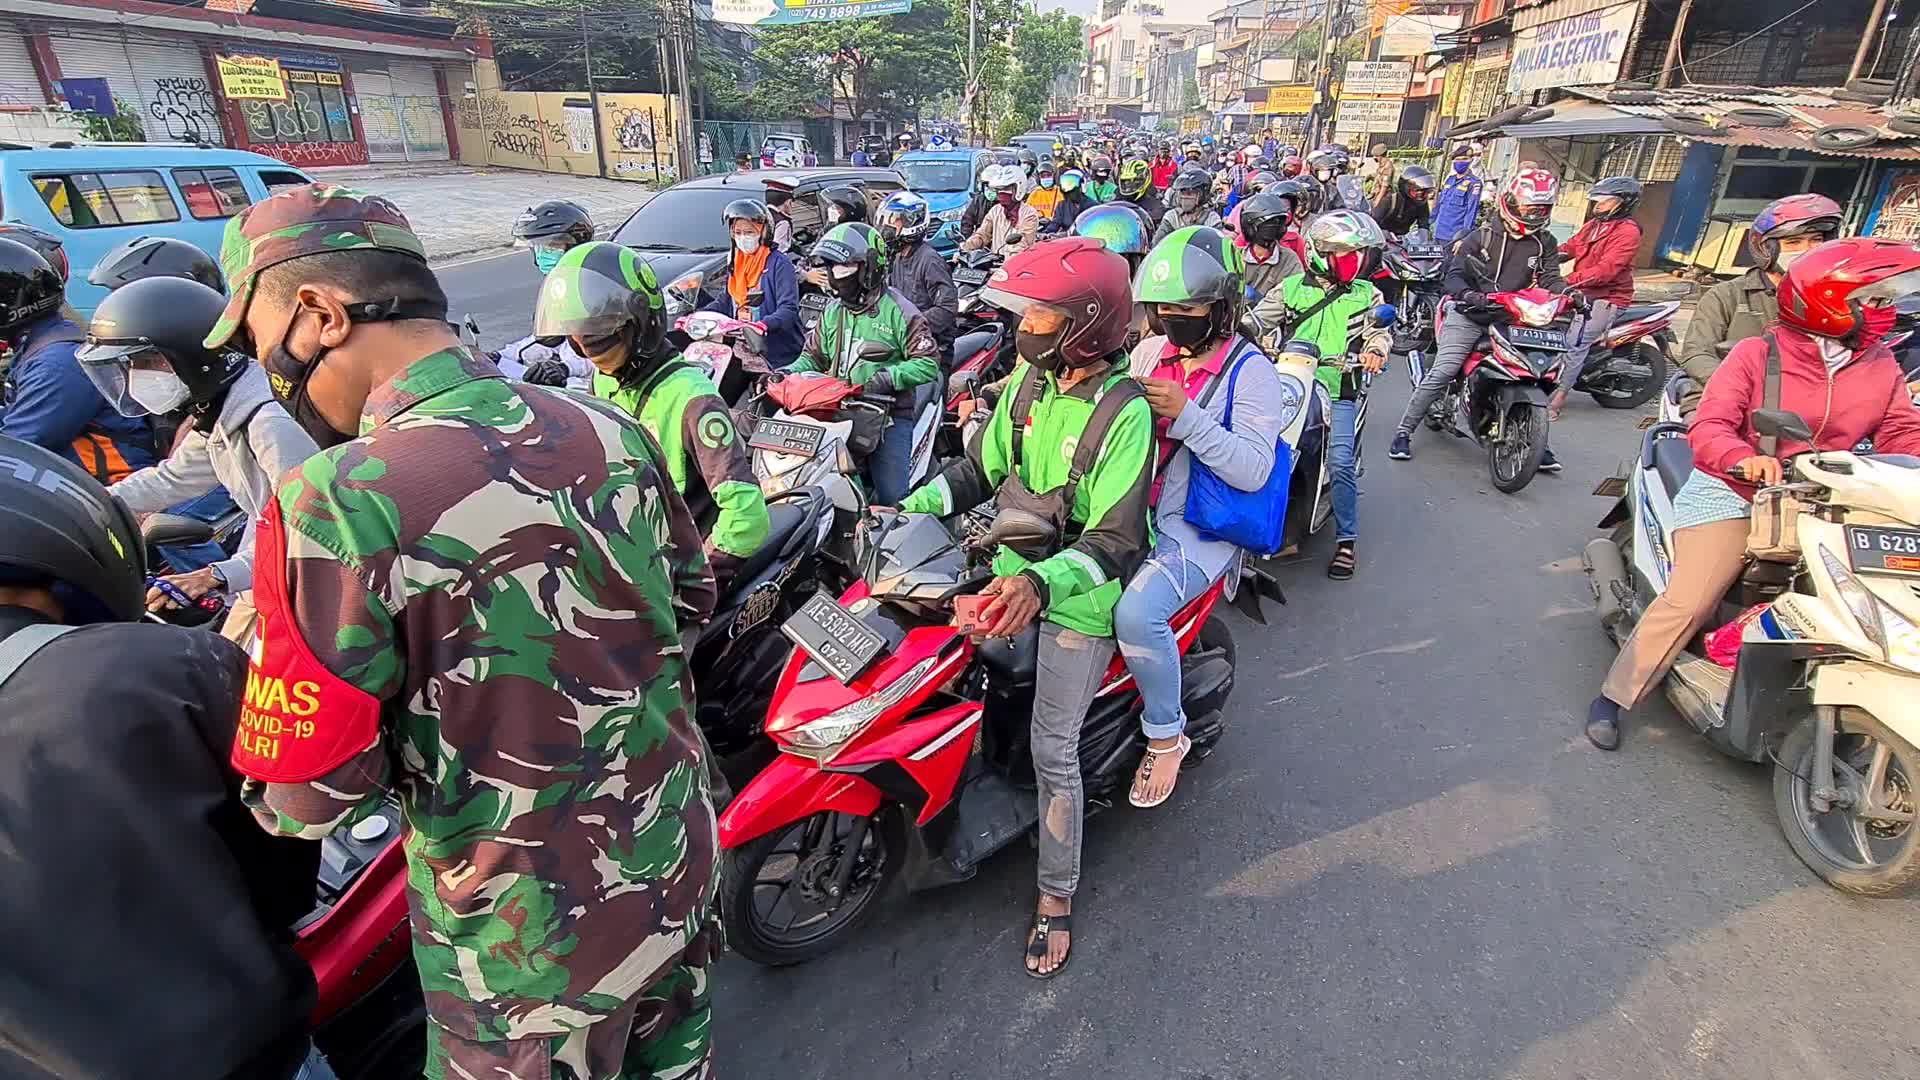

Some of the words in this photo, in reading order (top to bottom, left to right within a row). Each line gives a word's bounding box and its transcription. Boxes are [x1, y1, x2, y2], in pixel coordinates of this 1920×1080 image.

[804, 8, 826, 19] 749
[829, 4, 861, 18] 8898
[1560, 10, 1603, 37] LISTRIK
[1549, 30, 1618, 68] ELECTRIC
[321, 74, 337, 83] PUAS
[760, 422, 767, 433] B
[770, 424, 794, 437] 6871
[1857, 532, 1870, 549] B
[1786, 600, 1816, 632] HONDA
[807, 601, 830, 621] AE
[822, 612, 855, 643] 5932
[846, 632, 873, 659] MK
